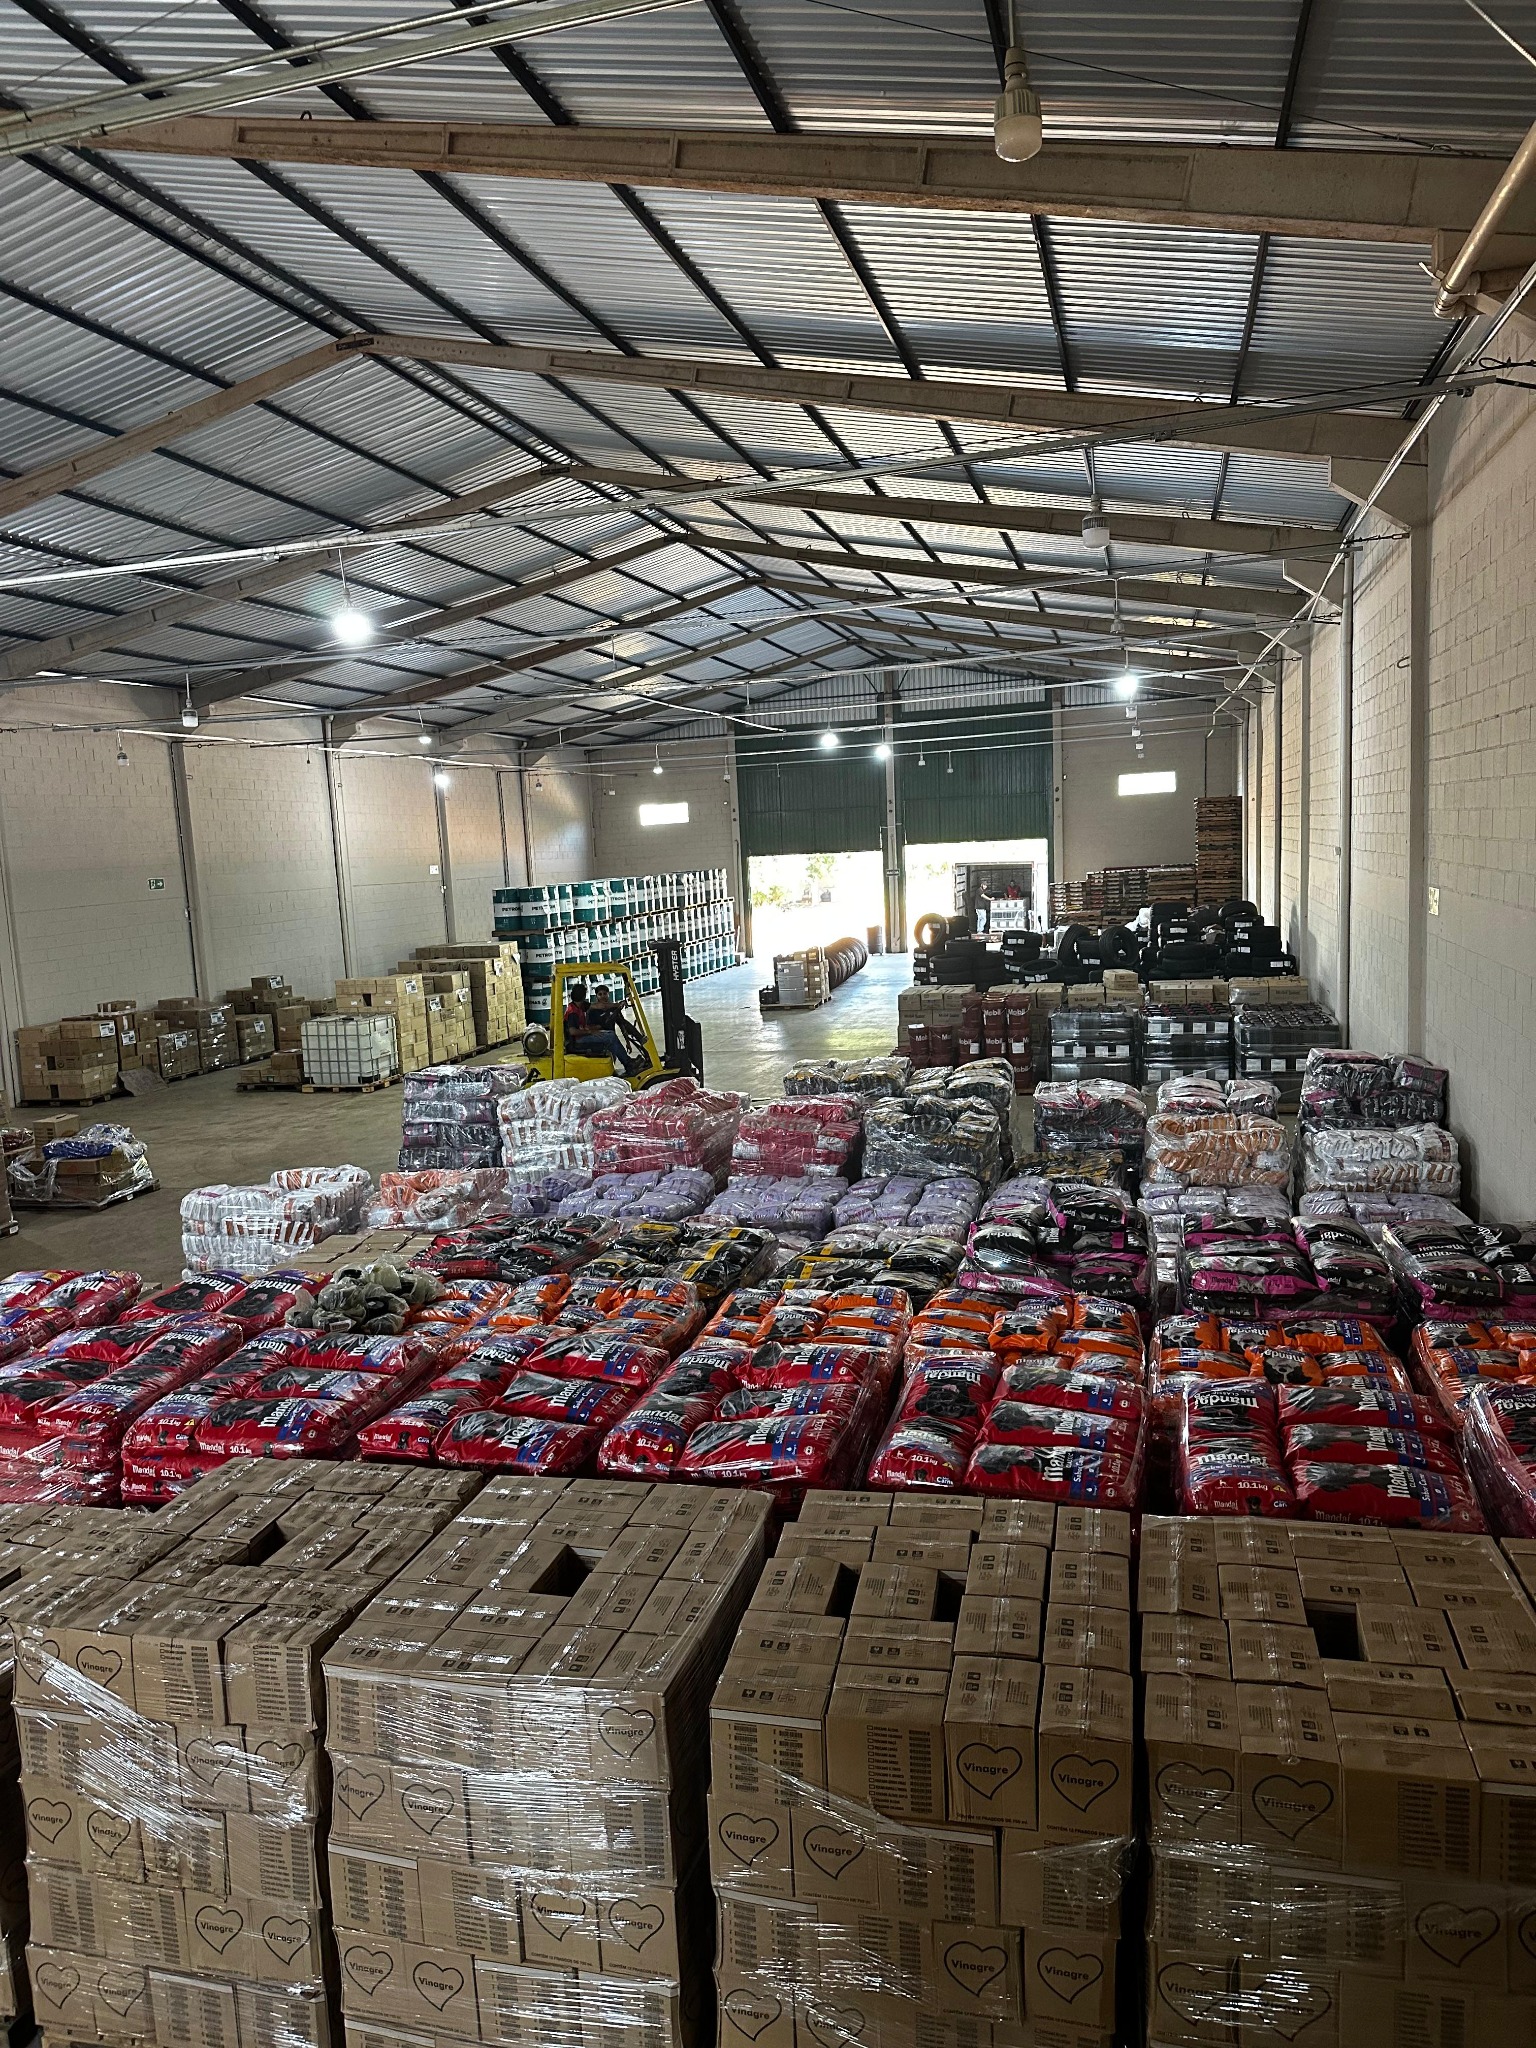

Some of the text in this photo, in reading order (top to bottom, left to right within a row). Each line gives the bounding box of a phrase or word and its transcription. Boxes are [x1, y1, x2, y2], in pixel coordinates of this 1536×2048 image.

[671, 950, 680, 981] HYSTER
[984, 1009, 1001, 1017] Mobil
[1237, 1481, 1268, 1491] 10.1kg
[81, 1660, 114, 1674] Vinagre
[604, 1726, 644, 1738] Vinagre
[190, 1754, 225, 1767] Vinagre
[964, 1762, 1010, 1776] Vinagre
[1059, 1773, 1105, 1788] Vinagre
[341, 1783, 375, 1798] Vinagre
[408, 1800, 445, 1814] Vinagre
[1262, 1796, 1316, 1813] Vinagre
[32, 1811, 64, 1825] Vinagre
[725, 1830, 767, 1845] Vinagre
[810, 1842, 853, 1857] Vinagre
[201, 1922, 234, 1934] Vinagre
[613, 1916, 654, 1930] Vinagre
[1425, 1924, 1482, 1940] Vinagre
[350, 1962, 385, 1976] Vinagre
[951, 1958, 996, 1974] Vinagre
[1045, 1965, 1090, 1981] Vinagre
[40, 1975, 72, 1990] Vinagre
[419, 1976, 455, 1991] Vinagre
[731, 2004, 771, 2020] Vinagre
